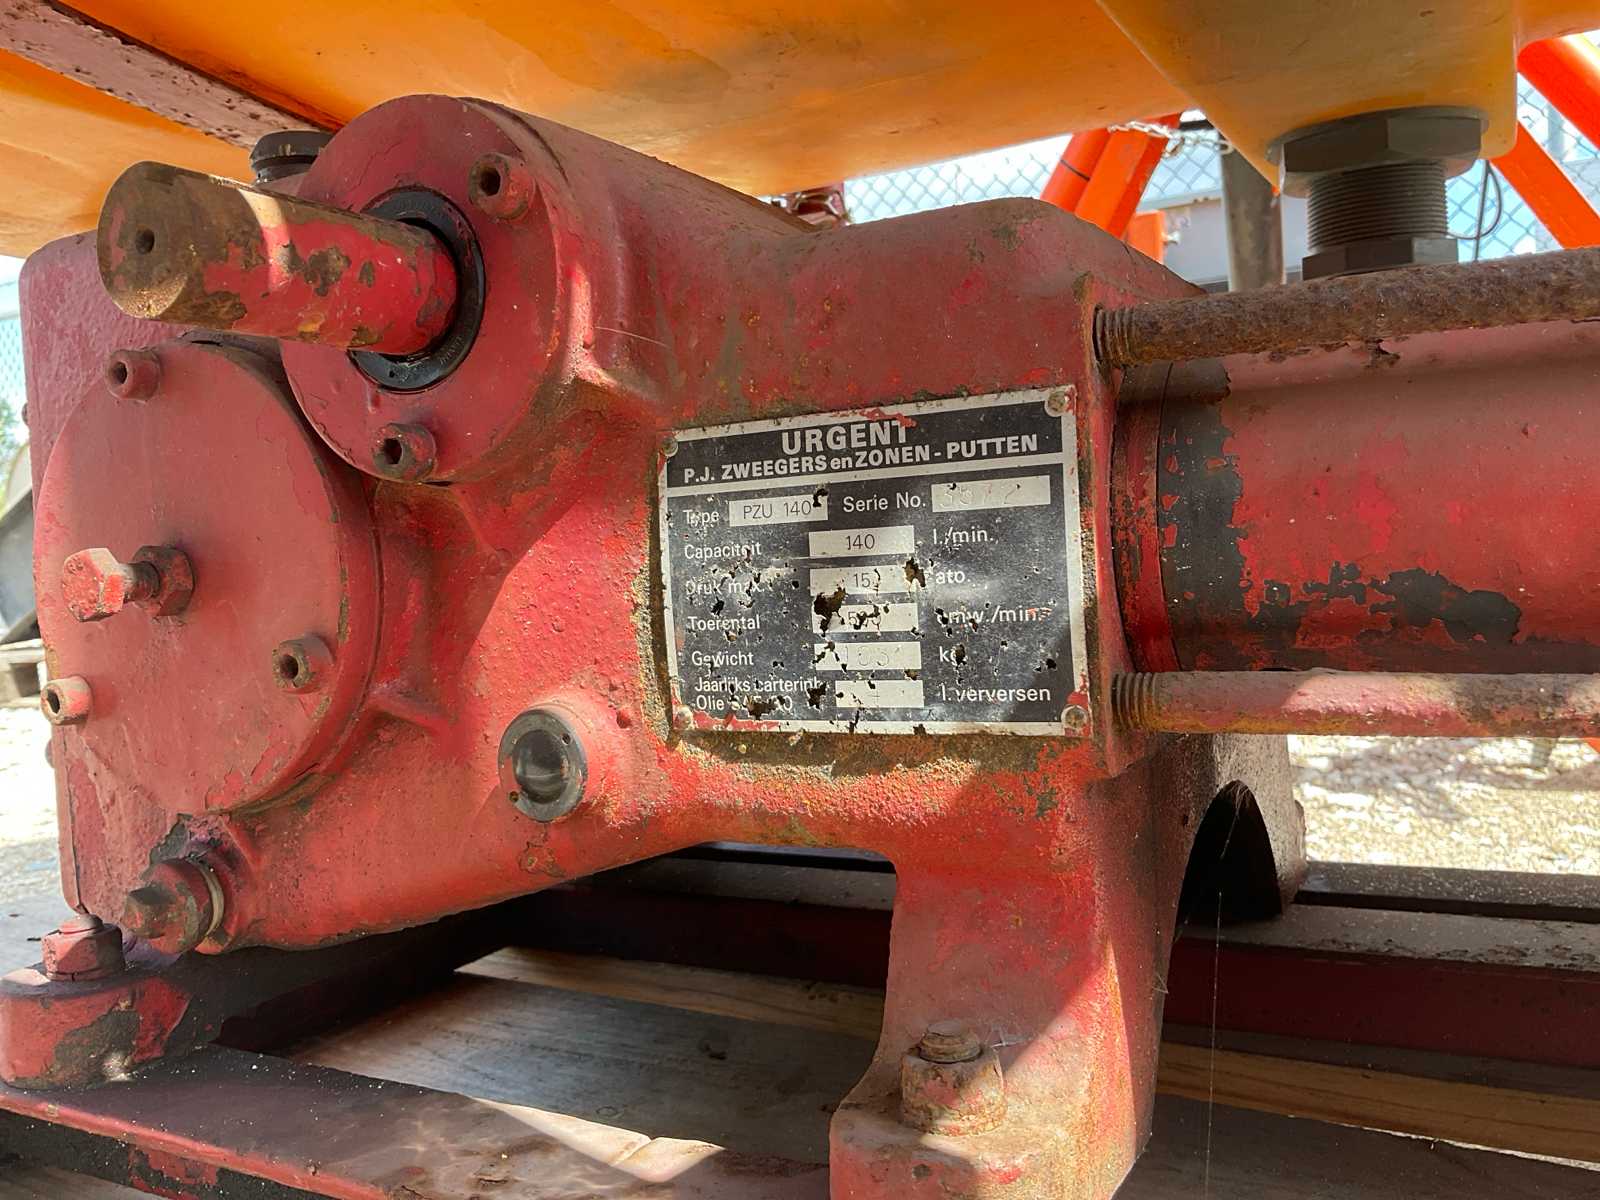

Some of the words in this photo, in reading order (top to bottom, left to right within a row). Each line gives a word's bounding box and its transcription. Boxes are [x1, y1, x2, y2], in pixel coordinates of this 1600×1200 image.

[781, 420, 909, 456] URGENT
[684, 467, 714, 484] P.J.
[721, 455, 827, 480] ZWEEGERS
[855, 444, 930, 467] ZONEN
[946, 434, 1038, 459] PUTTEN
[842, 494, 888, 513] Serie
[896, 492, 926, 509] No.
[682, 509, 720, 528] Type
[743, 503, 773, 519] PZU
[783, 500, 812, 517] 140
[684, 541, 762, 561] Capaciteit
[846, 533, 876, 551] 140
[685, 578, 722, 595] Druk
[687, 614, 760, 632] Toerental
[691, 650, 754, 667] Gewicht
[696, 694, 725, 711] Olie
[955, 687, 1051, 702] verversen
